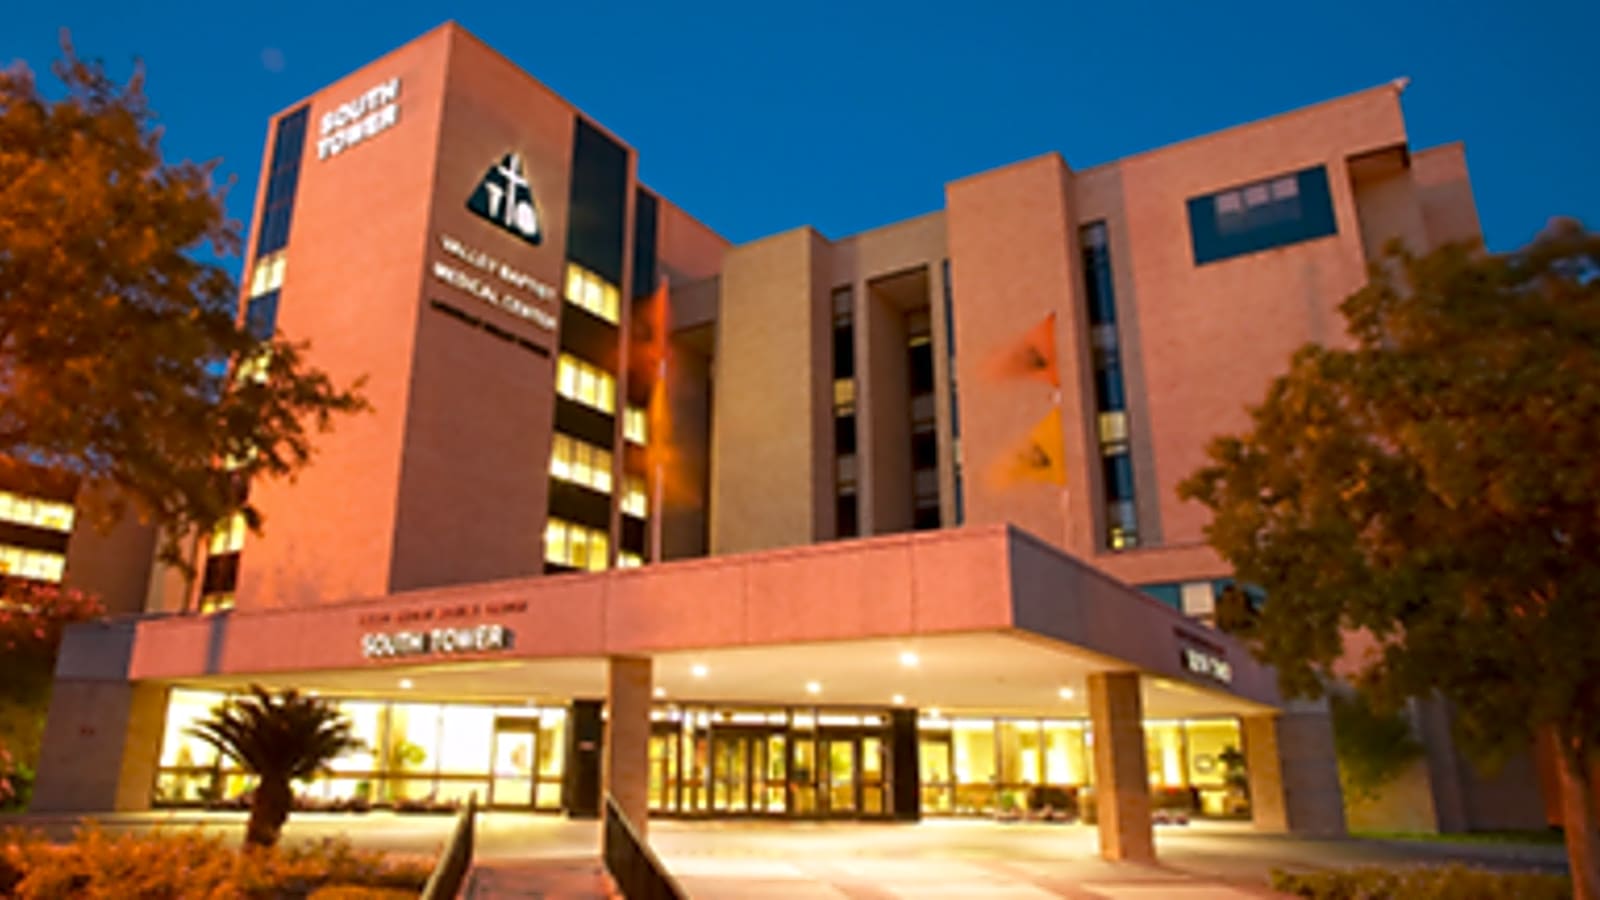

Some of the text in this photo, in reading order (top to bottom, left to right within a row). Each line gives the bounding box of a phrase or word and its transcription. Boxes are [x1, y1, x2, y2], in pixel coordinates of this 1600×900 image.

[317, 104, 399, 160] TOWER
[320, 78, 400, 136] SOUTH
[440, 234, 498, 273] VALLEY
[432, 262, 499, 306] MEDICAL
[501, 294, 558, 331] CENTER
[361, 624, 508, 658] SOUTH TOWER
